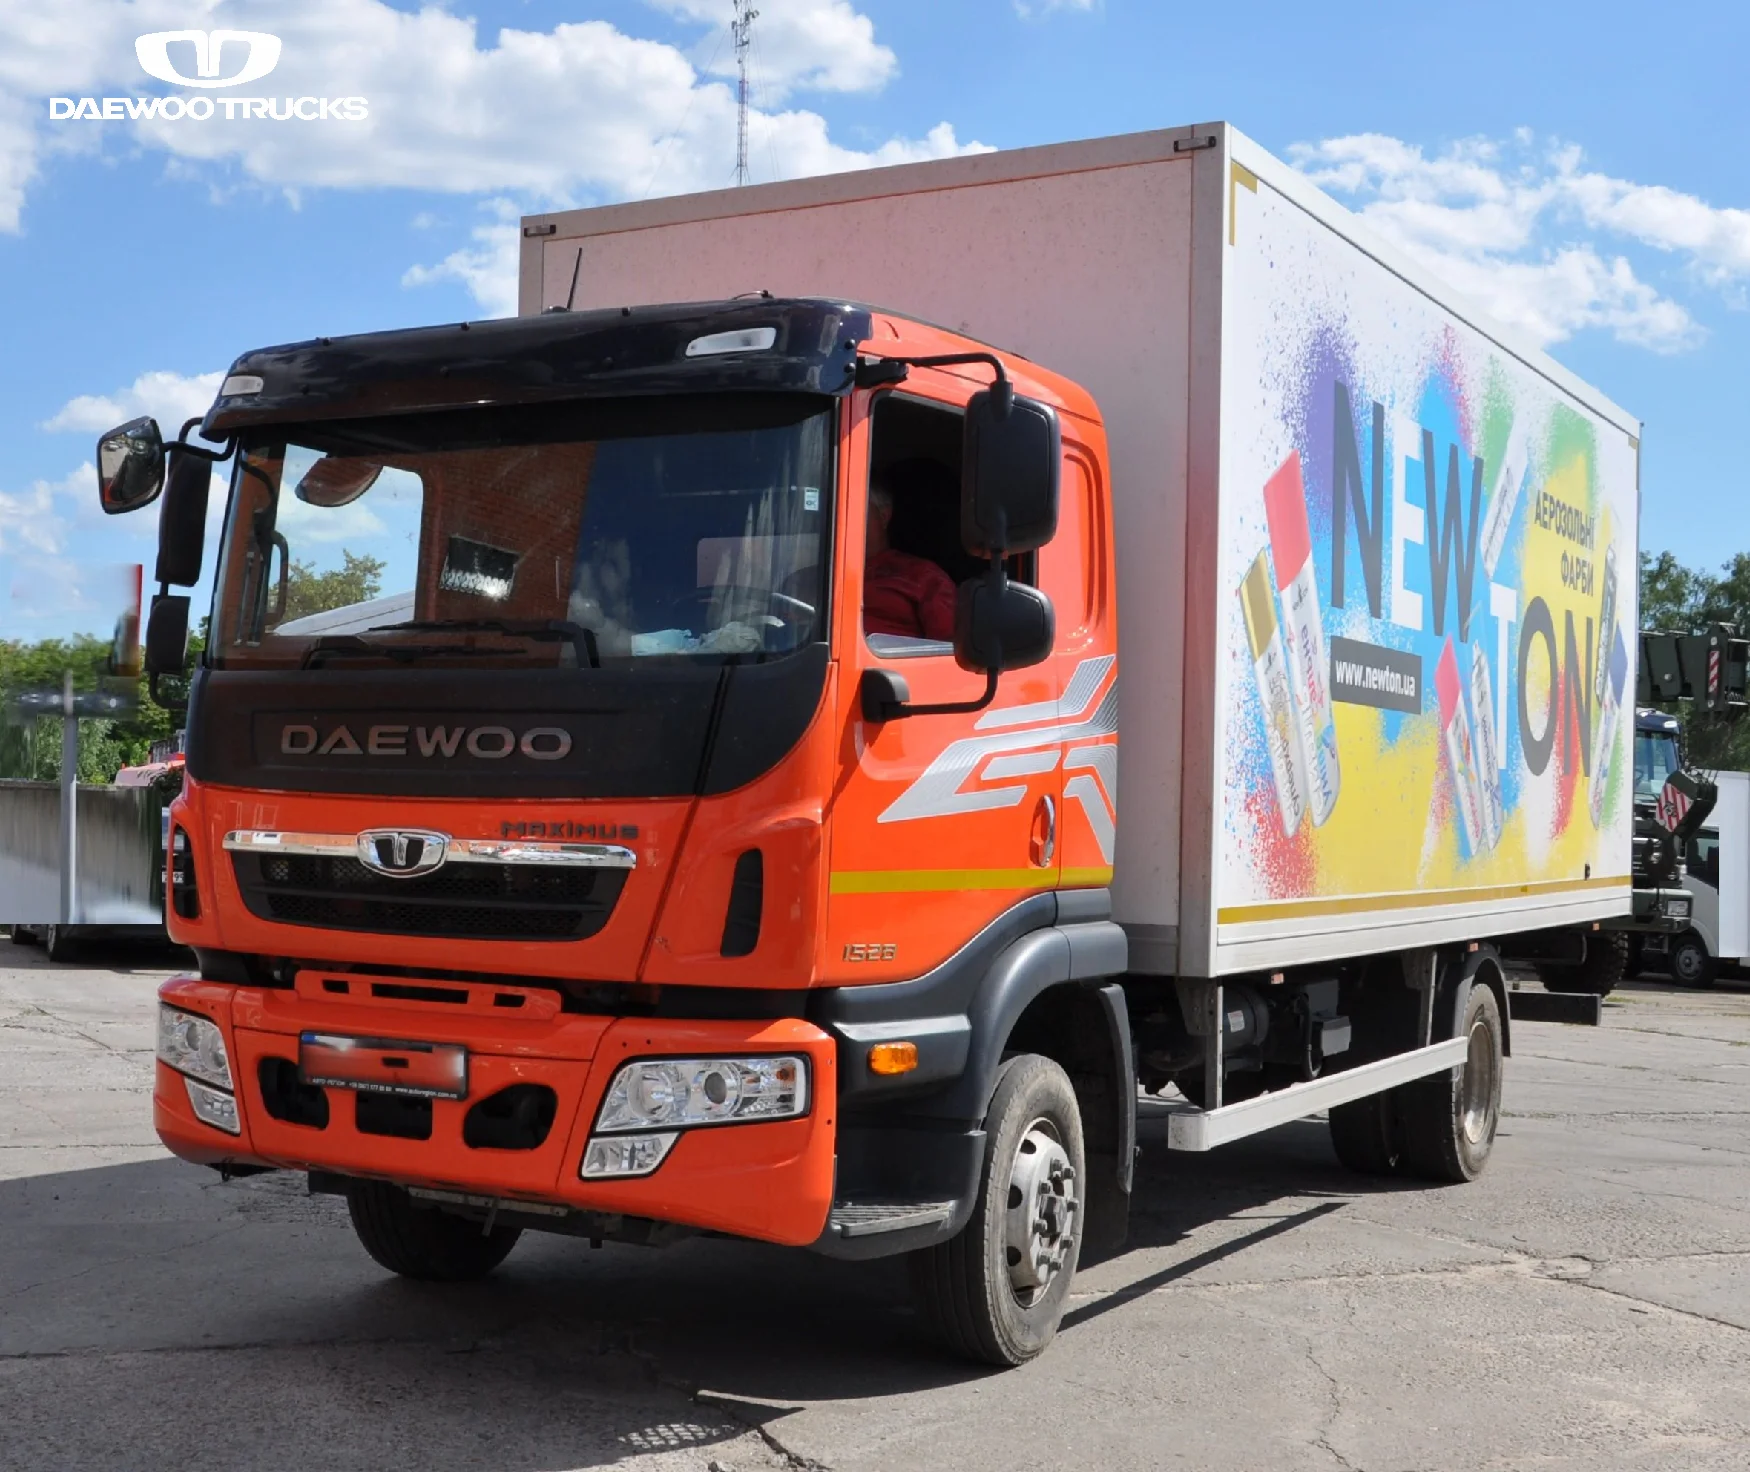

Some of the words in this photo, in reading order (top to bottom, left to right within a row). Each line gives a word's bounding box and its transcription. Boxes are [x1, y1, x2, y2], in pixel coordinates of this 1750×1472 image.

[1535, 489, 1594, 551] АЕРОЗОЛЬНІ
[1561, 550, 1594, 597] ФАРБИ
[1335, 660, 1416, 697] www.newton.ua
[280, 724, 573, 760] DAEWOO
